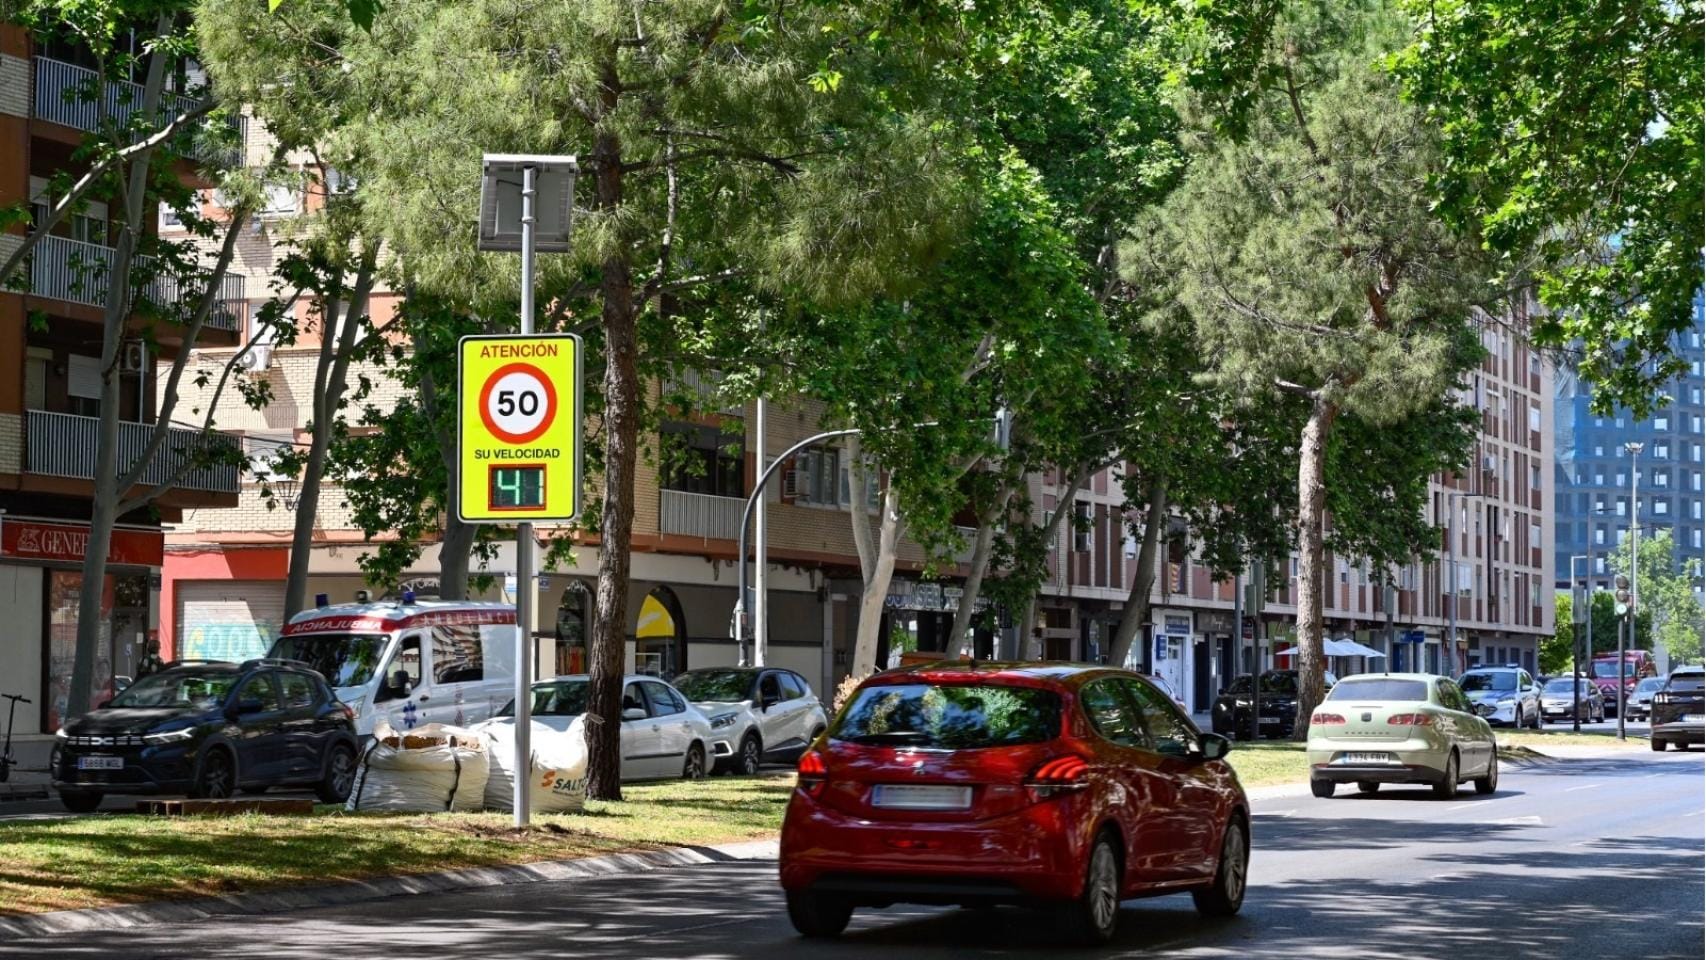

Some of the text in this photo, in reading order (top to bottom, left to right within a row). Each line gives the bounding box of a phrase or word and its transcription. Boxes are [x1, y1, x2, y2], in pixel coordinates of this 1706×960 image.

[480, 341, 558, 358] ATENCIÓN
[497, 390, 539, 416] 50
[474, 448, 560, 459] SU VELOCIDAD
[497, 469, 544, 505] 41
